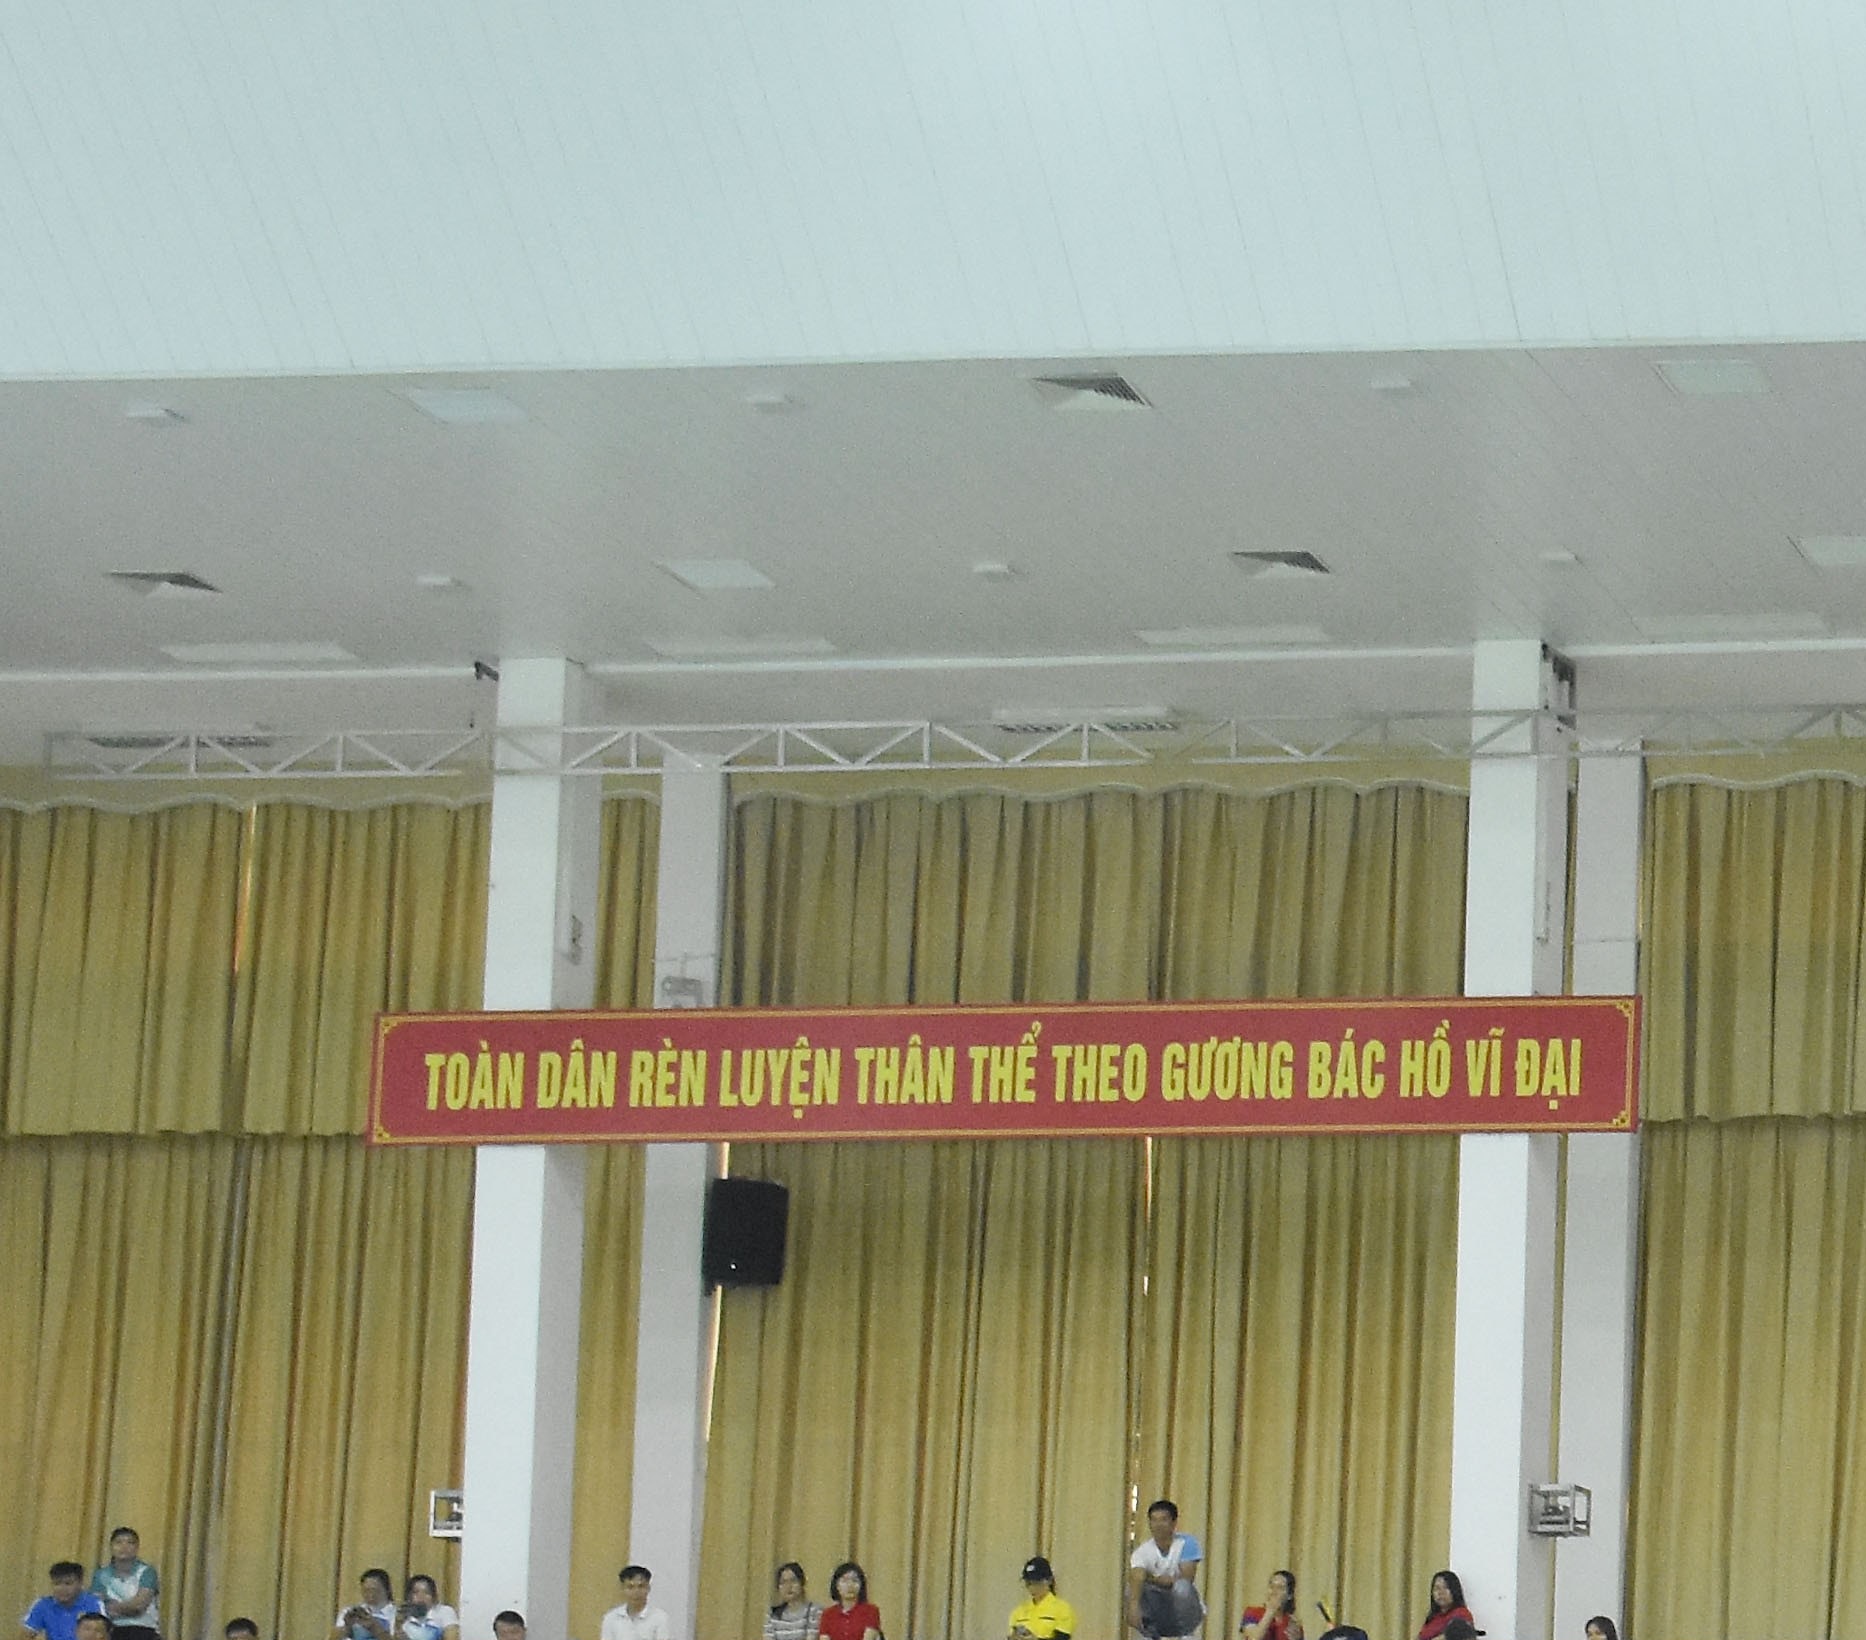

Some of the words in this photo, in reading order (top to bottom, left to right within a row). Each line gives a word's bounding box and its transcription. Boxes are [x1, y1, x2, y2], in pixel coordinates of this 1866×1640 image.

[424, 1040, 525, 1111] TOÀN
[536, 1038, 617, 1109] DÂN
[629, 1036, 707, 1108] RÈN
[719, 1036, 841, 1119] LUYỆN
[854, 1033, 955, 1105] THÂN
[968, 1021, 1042, 1104] THỂ
[1051, 1043, 1148, 1102] THEO
[1161, 1036, 1294, 1102] GƯƠNG
[1307, 1028, 1386, 1099] BÁC
[1399, 1020, 1451, 1098] HỒ
[1465, 1027, 1505, 1097] VĨ
[1514, 1038, 1582, 1110] ĐẠI
